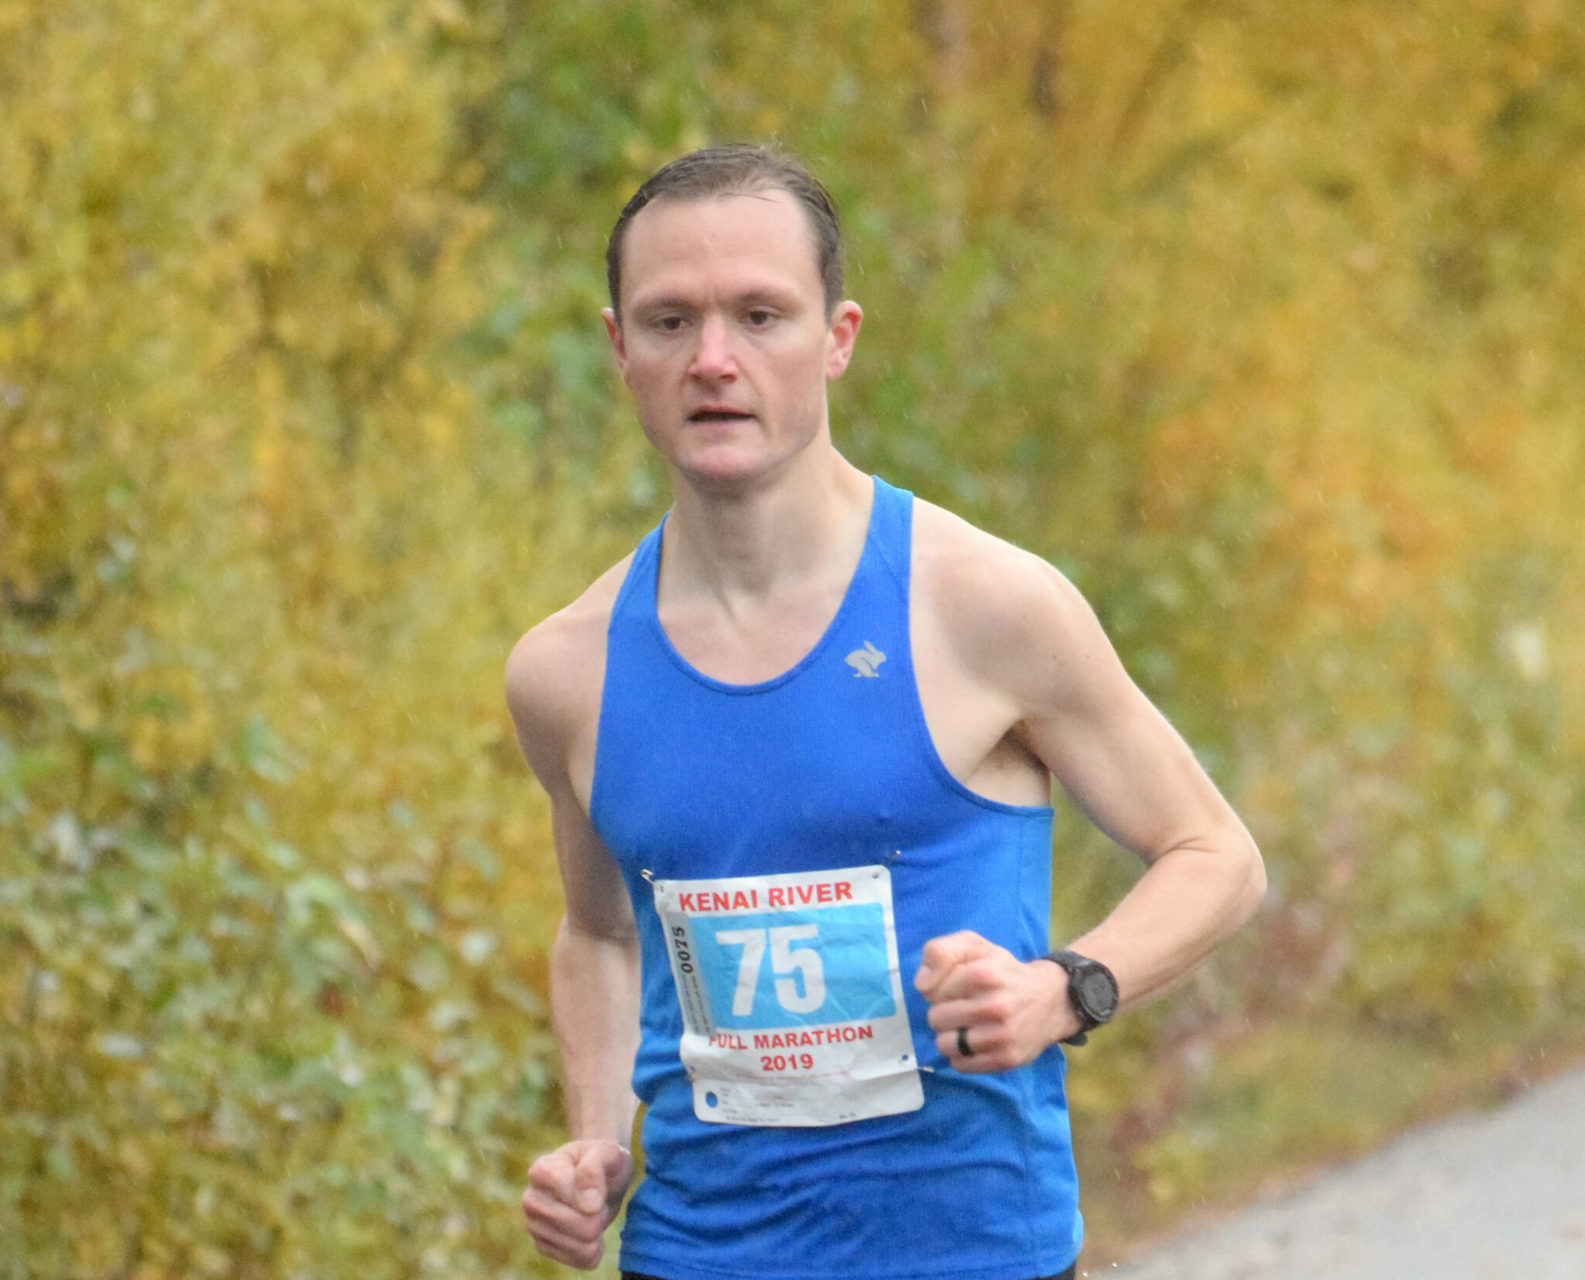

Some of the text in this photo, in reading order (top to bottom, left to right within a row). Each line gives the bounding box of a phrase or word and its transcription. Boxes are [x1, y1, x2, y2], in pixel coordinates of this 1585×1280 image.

[679, 881, 853, 912] KENAI RIVER
[672, 926, 694, 974] 0075
[715, 924, 826, 1016] 75
[754, 1025, 873, 1049] MARATHON
[761, 1053, 814, 1071] 2019
